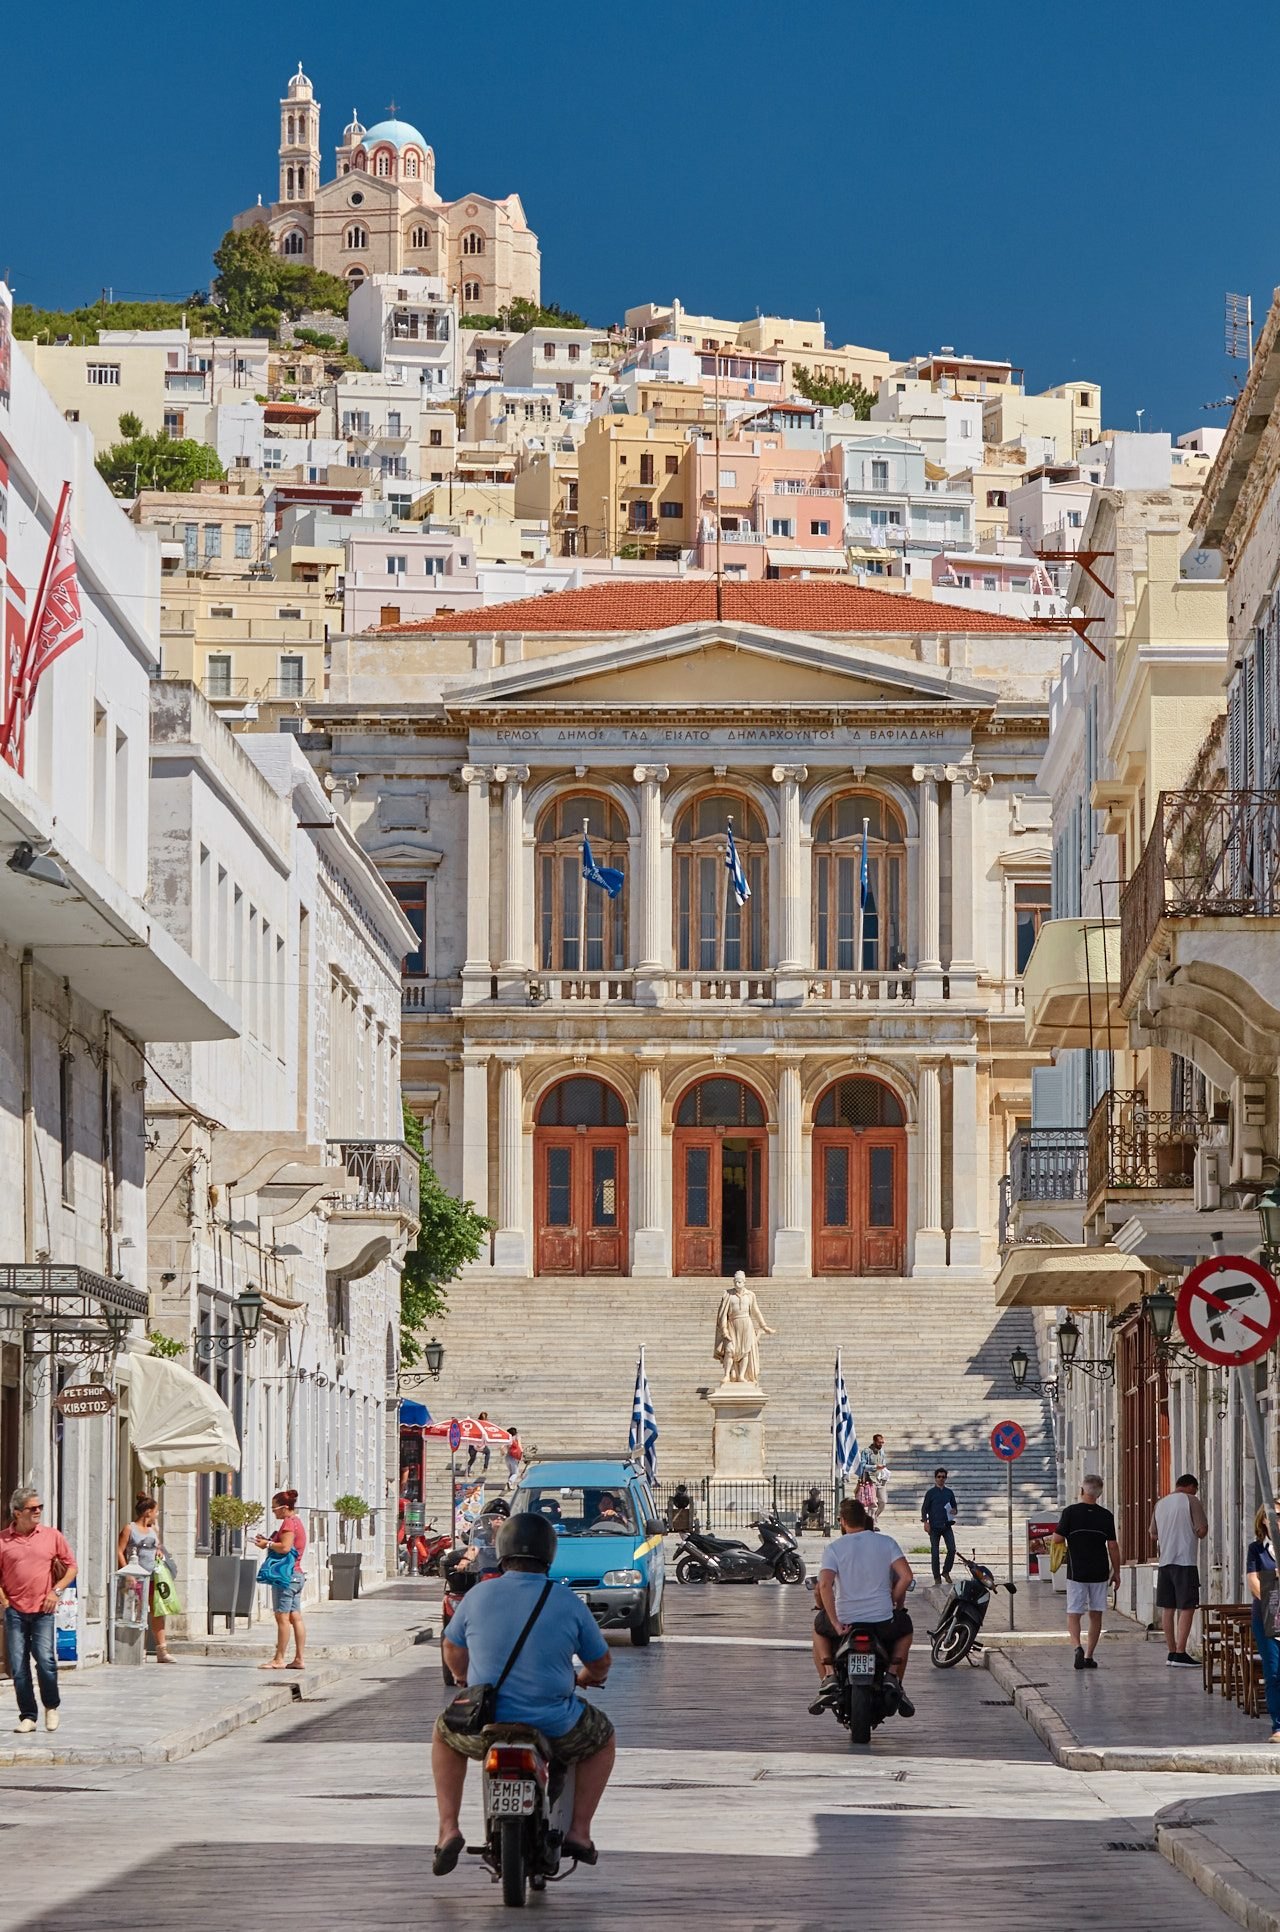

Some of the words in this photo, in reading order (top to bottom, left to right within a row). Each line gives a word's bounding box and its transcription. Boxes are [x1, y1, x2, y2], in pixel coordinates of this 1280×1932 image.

[496, 730, 540, 741] ΕΡΜΟΥ
[557, 730, 604, 741] ΔΗΜΟΣ
[727, 730, 835, 741] ΔΗΜΑΡΧΟΥΝΤΟΣ
[870, 730, 945, 741] ΒΑΦΙΑΔΑΚΗ
[64, 1389, 82, 1397] PET
[83, 1388, 105, 1396] SHOP
[63, 1401, 107, 1413] ΚΙΒΩΤΟΣ
[851, 1664, 867, 1673] 763
[492, 1797, 520, 1812] 498
